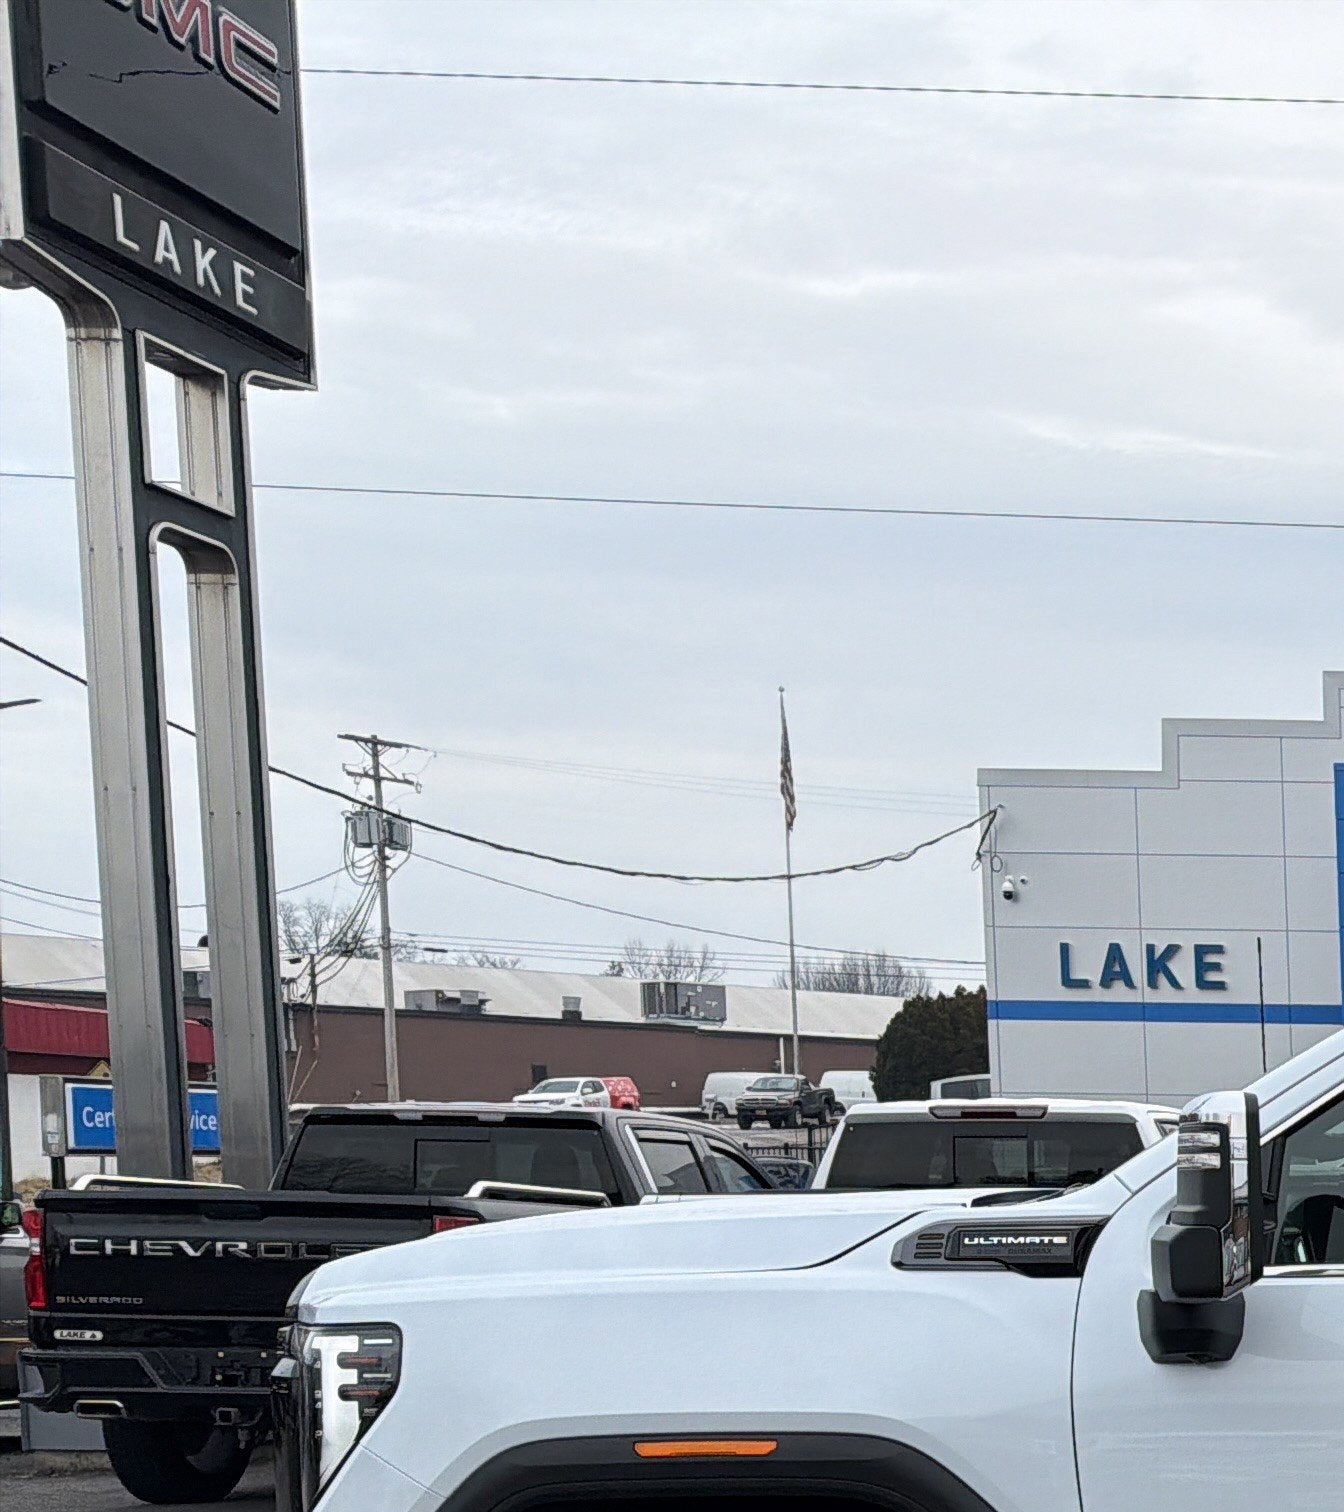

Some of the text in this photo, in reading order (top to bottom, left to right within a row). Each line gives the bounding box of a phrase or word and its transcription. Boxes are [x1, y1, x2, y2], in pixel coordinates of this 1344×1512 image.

[105, 0, 281, 114] MC
[111, 192, 259, 316] LAKE
[1058, 941, 1229, 992] LAKE
[69, 1238, 388, 1260] CHEVROLE
[963, 1236, 1068, 1245] ULTIMATE
[55, 1295, 144, 1305] SILVERADO
[58, 1330, 87, 1340] LAKE
